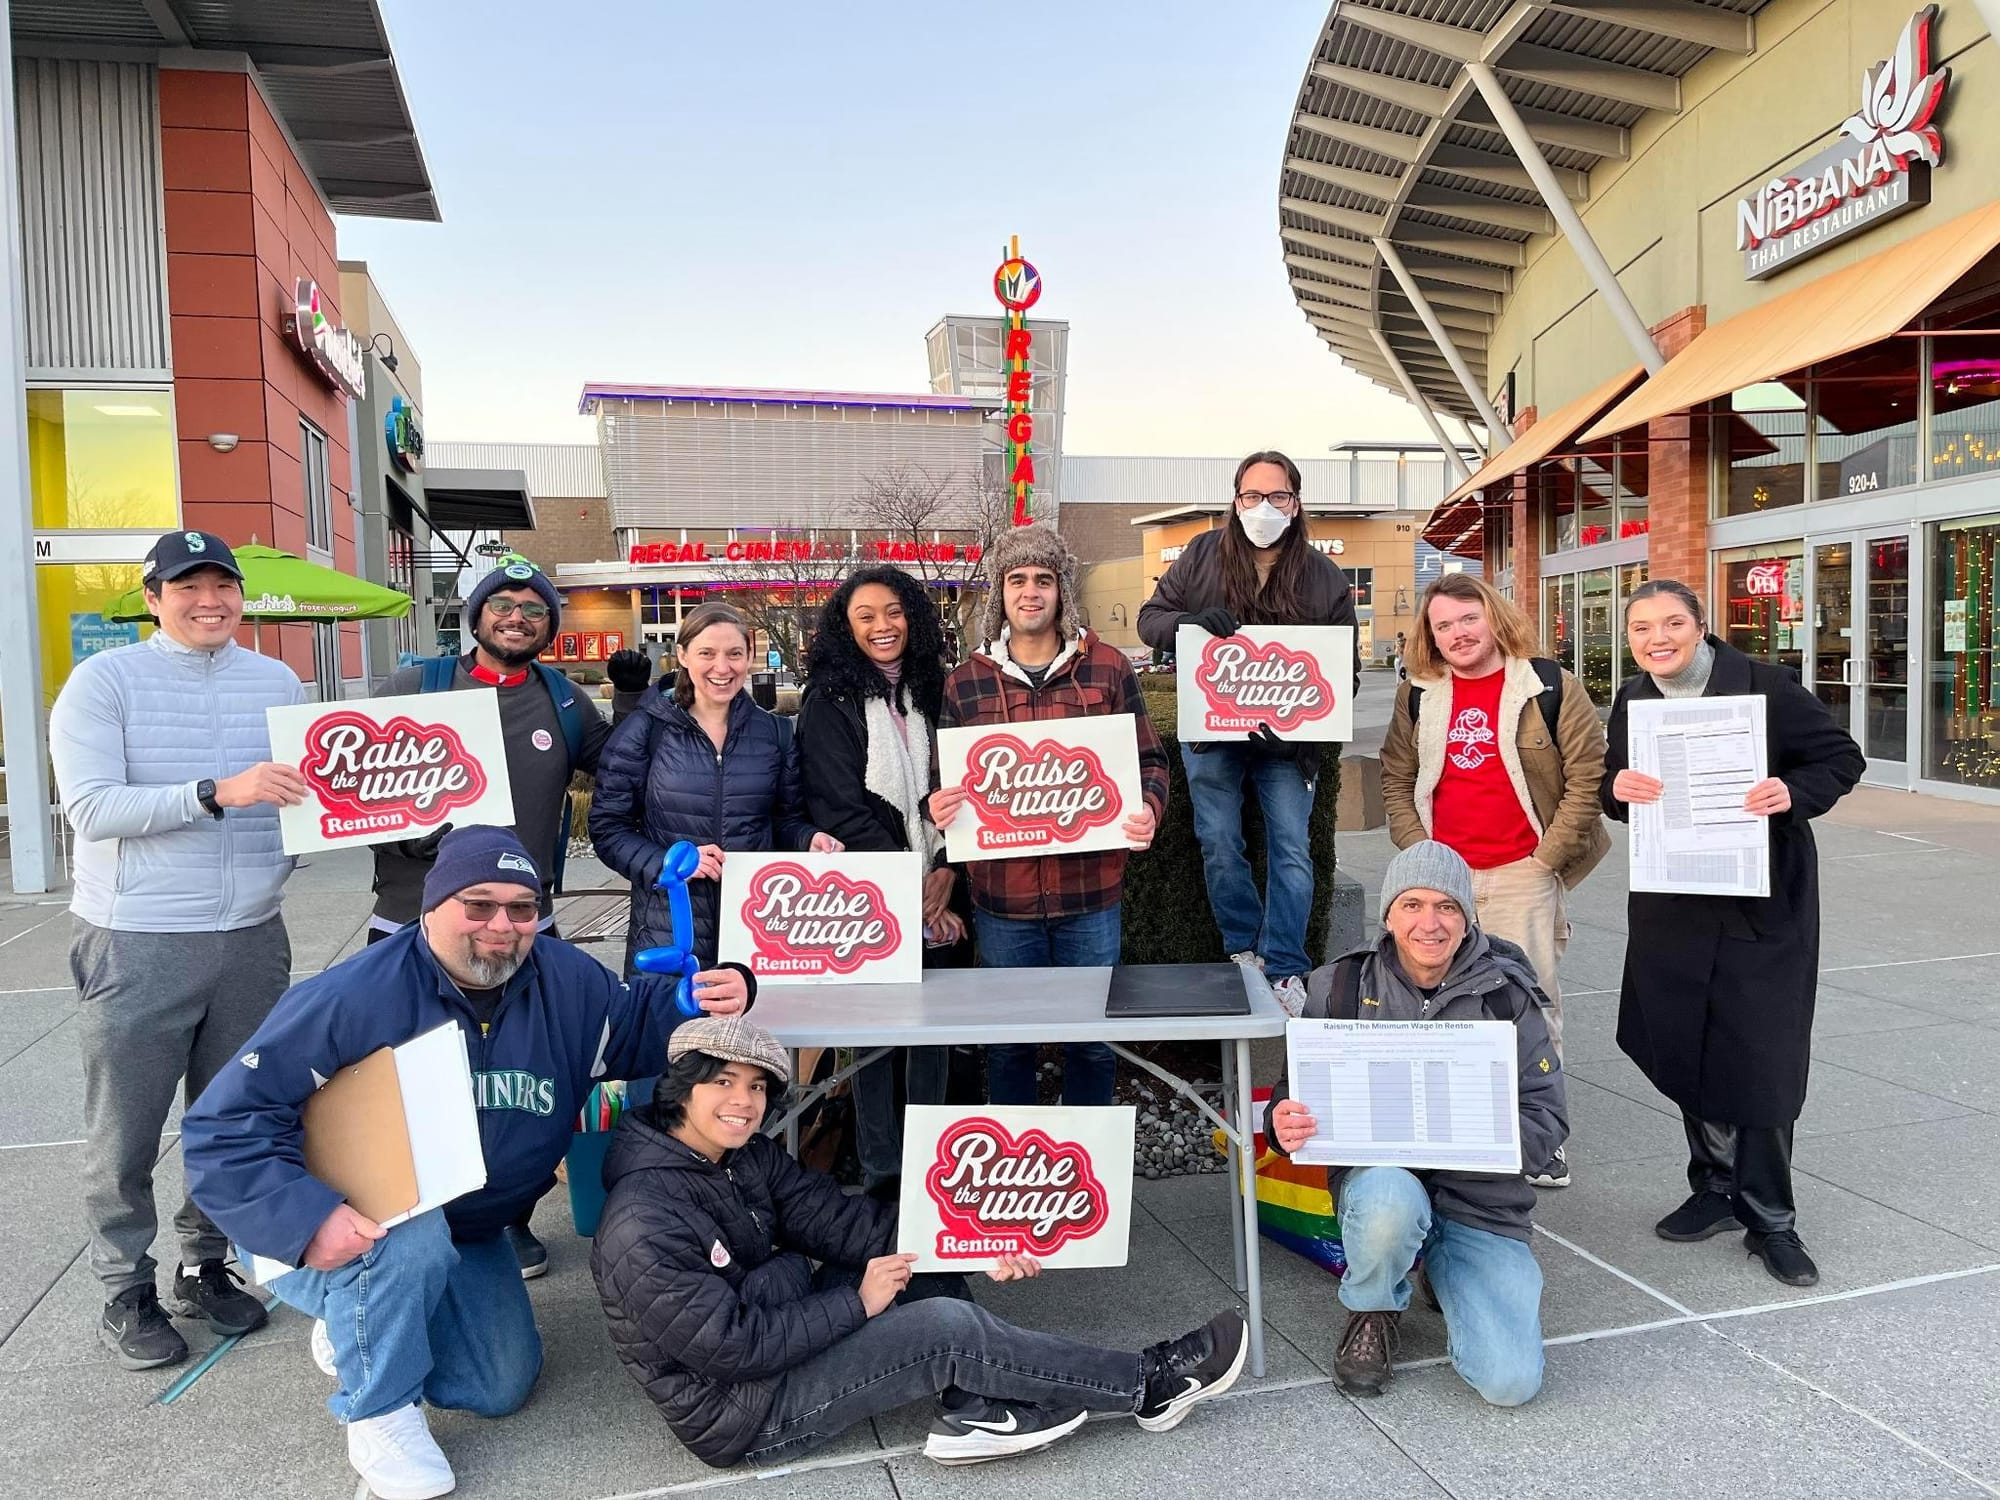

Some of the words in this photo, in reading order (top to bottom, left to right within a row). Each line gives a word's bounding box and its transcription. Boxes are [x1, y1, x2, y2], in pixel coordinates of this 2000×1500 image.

[1751, 240, 1784, 270] THAI
[1793, 181, 1901, 250] RESTAURANT
[1005, 329, 1034, 527] REGAL
[1849, 472, 1878, 494] 920-A
[1396, 524, 1410, 532] 910
[480, 545, 511, 554] papaya
[630, 543, 710, 564] REGAL
[1747, 572, 1778, 595] OPEN
[299, 603, 327, 611] frozen
[329, 605, 358, 613] yogurt
[1207, 644, 1308, 682] Raise
[1216, 679, 1237, 694] the
[1236, 685, 1320, 718] wage
[315, 725, 447, 776] Raise
[973, 746, 1088, 792] Raise
[331, 770, 358, 789] the
[358, 764, 468, 809] wage
[326, 813, 403, 834] Renton
[987, 788, 1009, 805] the
[1009, 786, 1105, 826] wage
[982, 830, 1047, 845] Renton
[753, 874, 871, 919] Raise
[765, 916, 789, 931] the
[787, 919, 885, 958] wage
[756, 957, 822, 970] Renton
[1323, 1022, 1353, 1031] Raising
[1410, 1023, 1433, 1031] Wage
[474, 1071, 555, 1115] INERS
[940, 1132, 1075, 1188] Raise
[954, 1185, 981, 1204] the
[978, 1190, 1091, 1237] wage
[942, 1236, 1018, 1253] Renton
